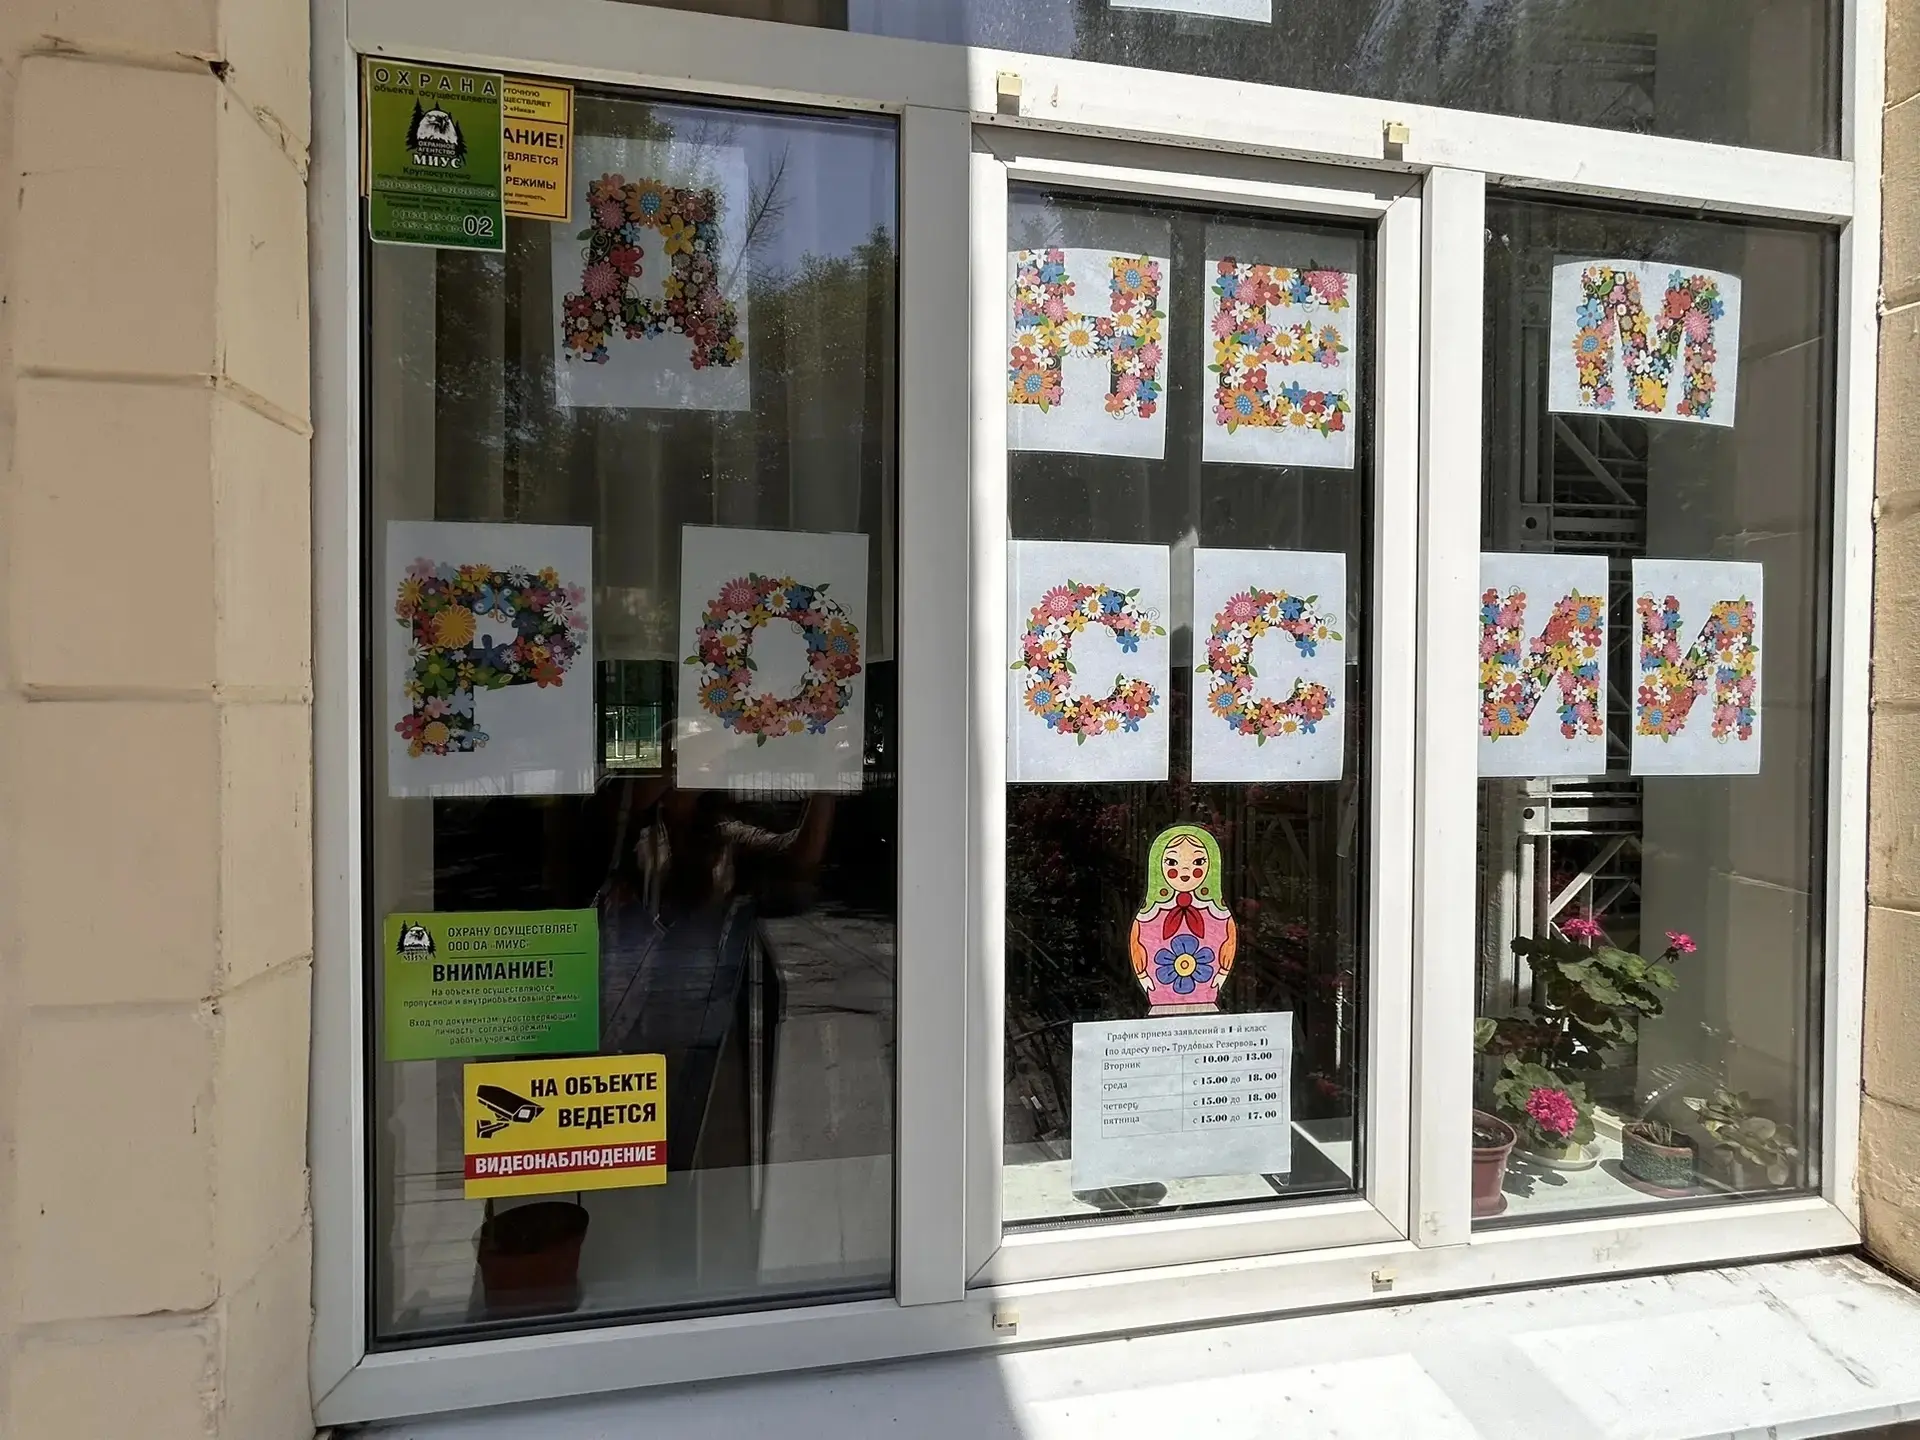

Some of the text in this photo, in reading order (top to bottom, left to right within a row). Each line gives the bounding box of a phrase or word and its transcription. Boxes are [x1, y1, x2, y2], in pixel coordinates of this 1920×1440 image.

[375, 68, 497, 96] ОХРАНА
[373, 84, 498, 105] объекта осуществляется
[504, 127, 564, 149] АНИЕ!
[413, 154, 462, 169] МИУС
[504, 151, 559, 166] ВЛЯЕТСЯ
[505, 176, 556, 190] РЕЖИМЫ
[462, 214, 495, 237] 02
[447, 923, 579, 937] ОХРАНУ ОСУЩЕСТВЛЯЕТ
[447, 940, 470, 951] ООО
[473, 940, 488, 951] ОА
[432, 960, 554, 982] ВНИМАНИЕ!
[431, 985, 555, 997] На объекте осуществляются
[403, 998, 453, 1009] пропускной
[409, 1018, 431, 1028] Вход
[433, 1018, 443, 1026] по
[478, 1024, 518, 1034] согласно
[450, 1035, 482, 1045] работы
[1107, 1032, 1139, 1043] График
[1141, 1030, 1172, 1041] приема
[1173, 1026, 1219, 1038] заявлений
[1244, 1024, 1268, 1034] класс
[1105, 1047, 1120, 1057] (по
[1121, 1046, 1150, 1057] адресу
[1103, 1061, 1141, 1070] Вторник
[1202, 1054, 1230, 1064] 10.00
[1231, 1055, 1243, 1064] до
[1245, 1051, 1273, 1062] 13.00
[530, 1071, 658, 1098] НА ОБЪЕКТЕ
[1103, 1081, 1128, 1091] среда
[1200, 1075, 1228, 1085] 15.00
[1230, 1076, 1241, 1085] до
[1200, 1096, 1228, 1106] 15.00
[1230, 1096, 1241, 1105] до
[558, 1102, 656, 1129] ВЕДЕТСЯ
[1103, 1116, 1140, 1125] пятница
[1200, 1114, 1228, 1124] 15.00
[1230, 1114, 1241, 1123] до
[475, 1145, 657, 1175] ВИДЕОНАБЛЮДЕНИЕ
